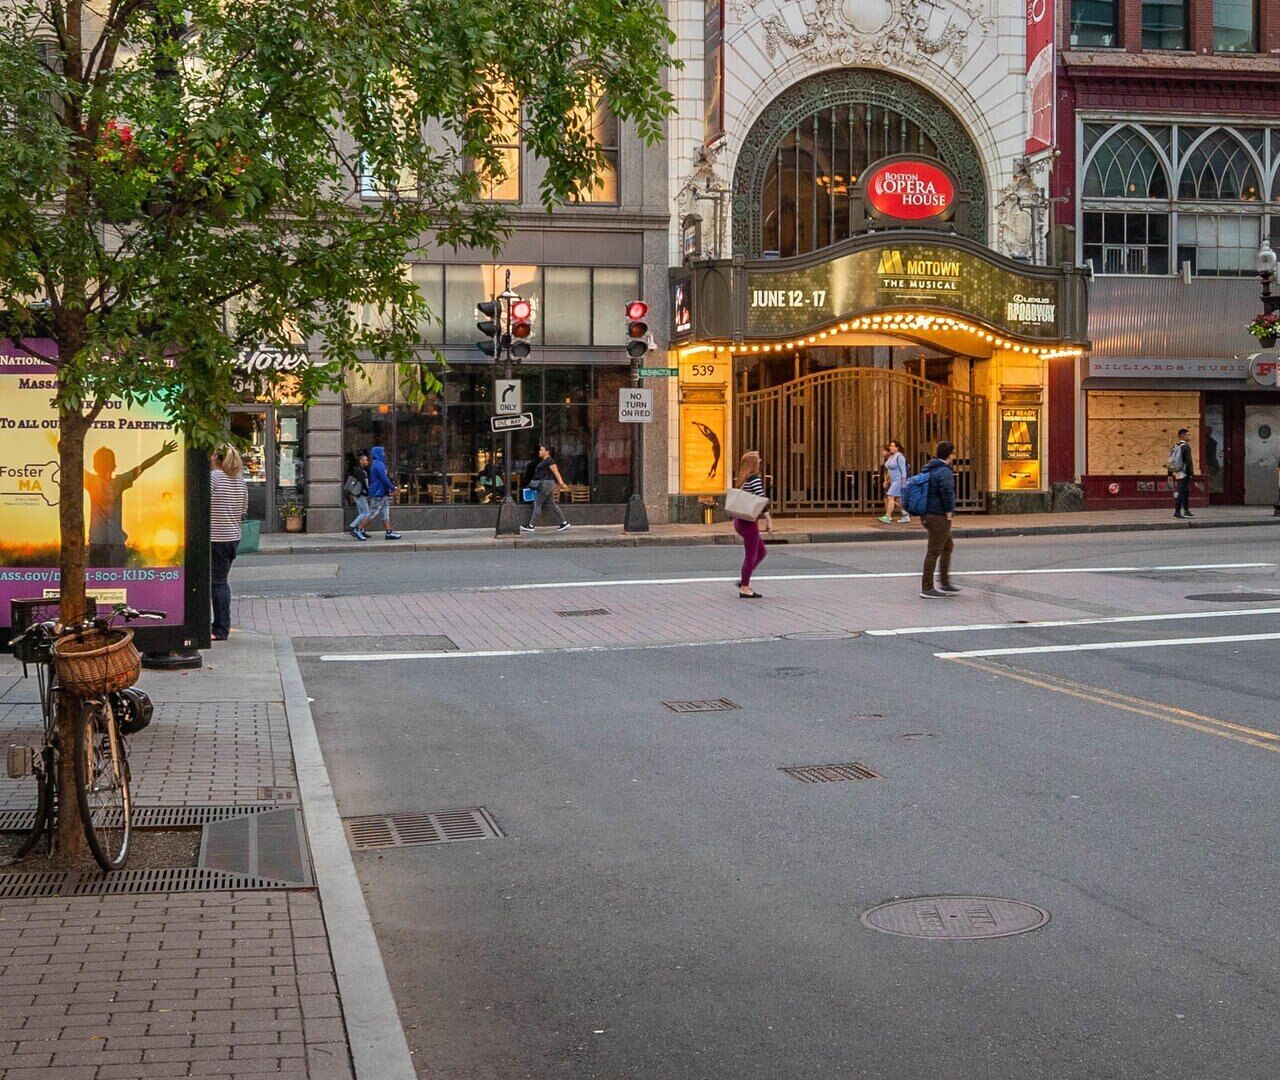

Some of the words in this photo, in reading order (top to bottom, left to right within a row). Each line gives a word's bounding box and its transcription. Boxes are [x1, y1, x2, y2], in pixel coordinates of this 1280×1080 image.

[885, 172, 918, 181] BOSTON
[883, 180, 936, 194] OPERA
[902, 194, 946, 206] HOUSE
[907, 260, 960, 277] MOTOWN
[883, 279, 904, 288] THE
[909, 280, 957, 290] MUSICAL
[751, 290, 786, 307] JUNE
[787, 290, 803, 307] 12
[812, 290, 826, 307] 17
[1007, 303, 1056, 317] BROADWAY
[1019, 310, 1055, 322] BOSTON
[640, 368, 672, 377] WASHINGTON
[692, 365, 715, 376] 539
[1094, 363, 1183, 371] BILLIARDS
[629, 392, 642, 400] NO
[625, 401, 647, 409] TURN
[621, 409, 633, 417] ON
[634, 409, 651, 417] RED
[0, 466, 44, 478] Foster
[18, 480, 43, 492] MA
